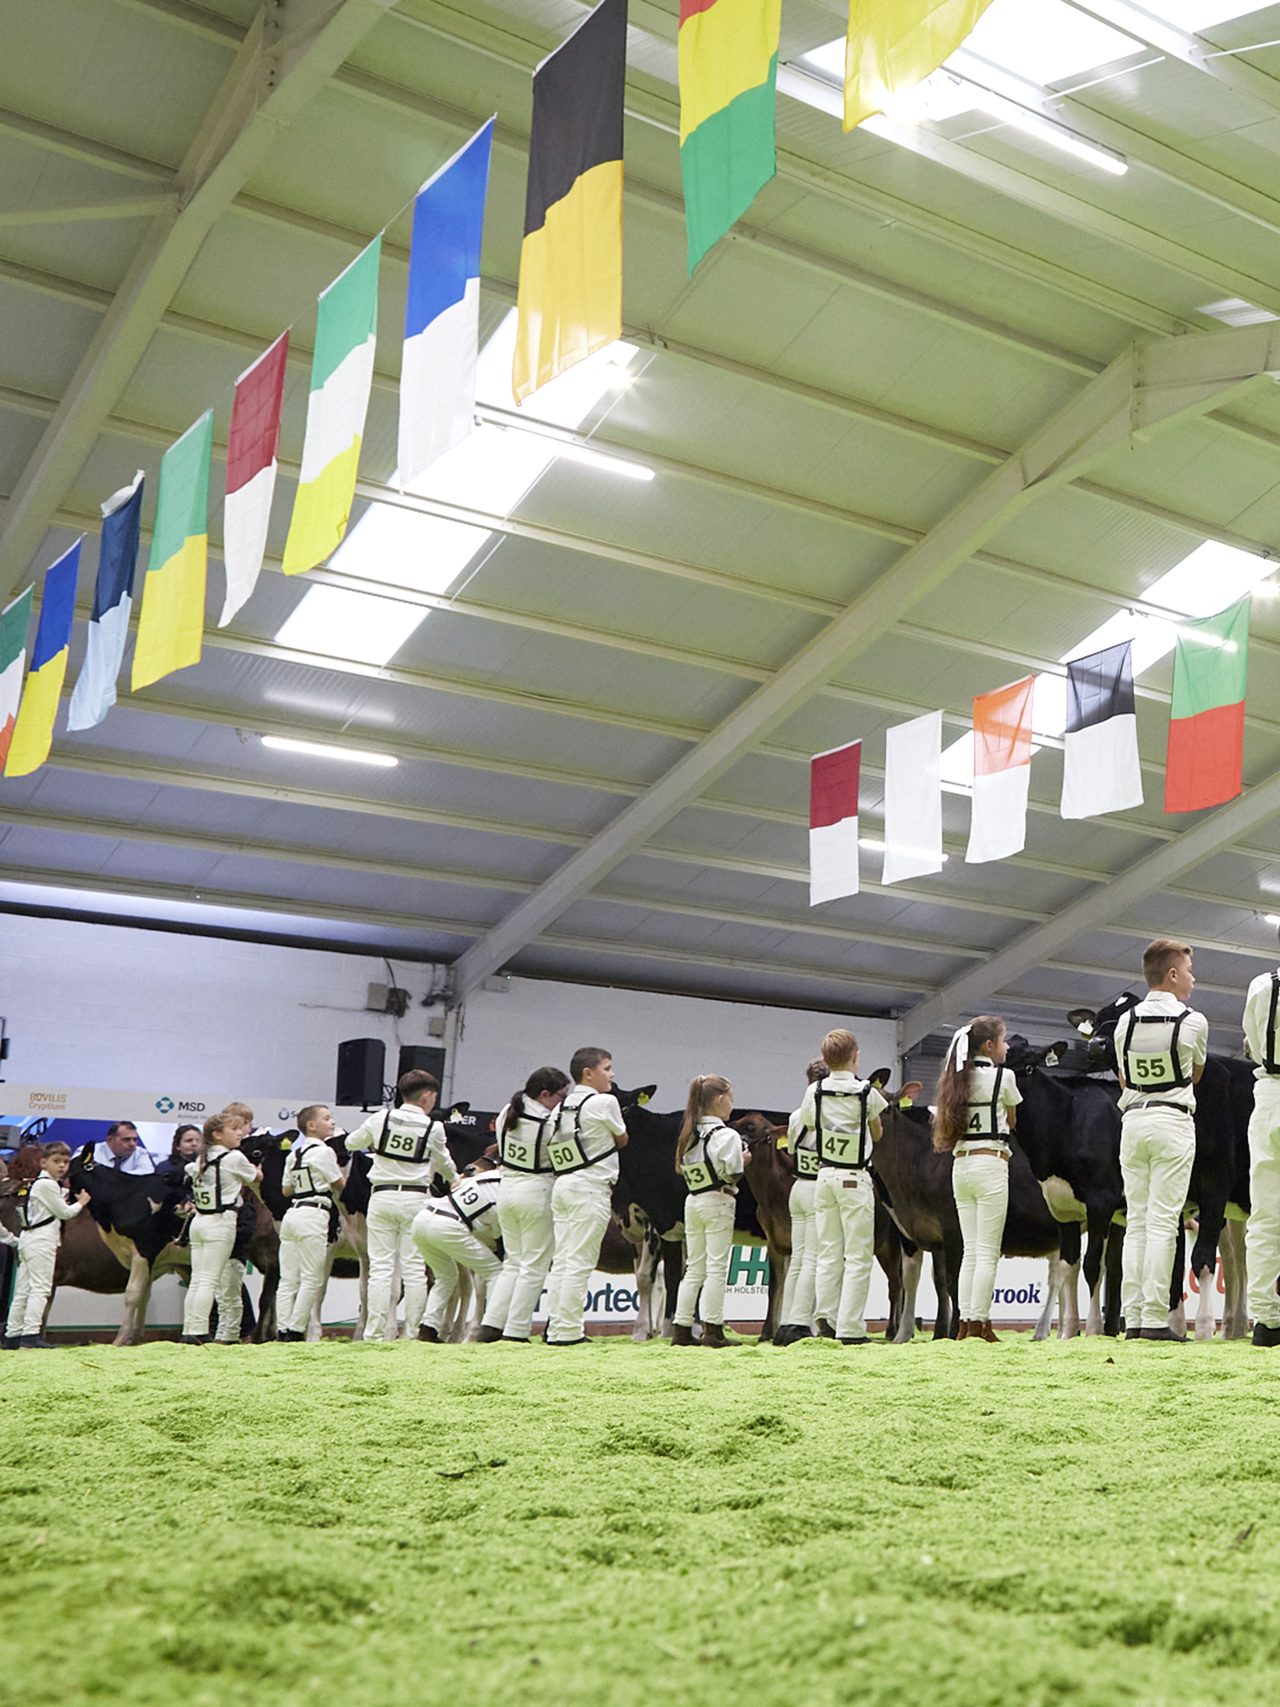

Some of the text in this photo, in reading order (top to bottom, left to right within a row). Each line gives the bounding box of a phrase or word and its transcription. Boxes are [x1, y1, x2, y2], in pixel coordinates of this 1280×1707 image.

[1136, 1058, 1166, 1078] 55
[178, 1101, 205, 1112] MSD
[389, 1134, 414, 1152] 58
[507, 1143, 528, 1163] 52
[825, 1136, 850, 1156] 47
[552, 1146, 574, 1166] 50
[799, 1155, 820, 1172] 53
[991, 1283, 1041, 1304] rook
